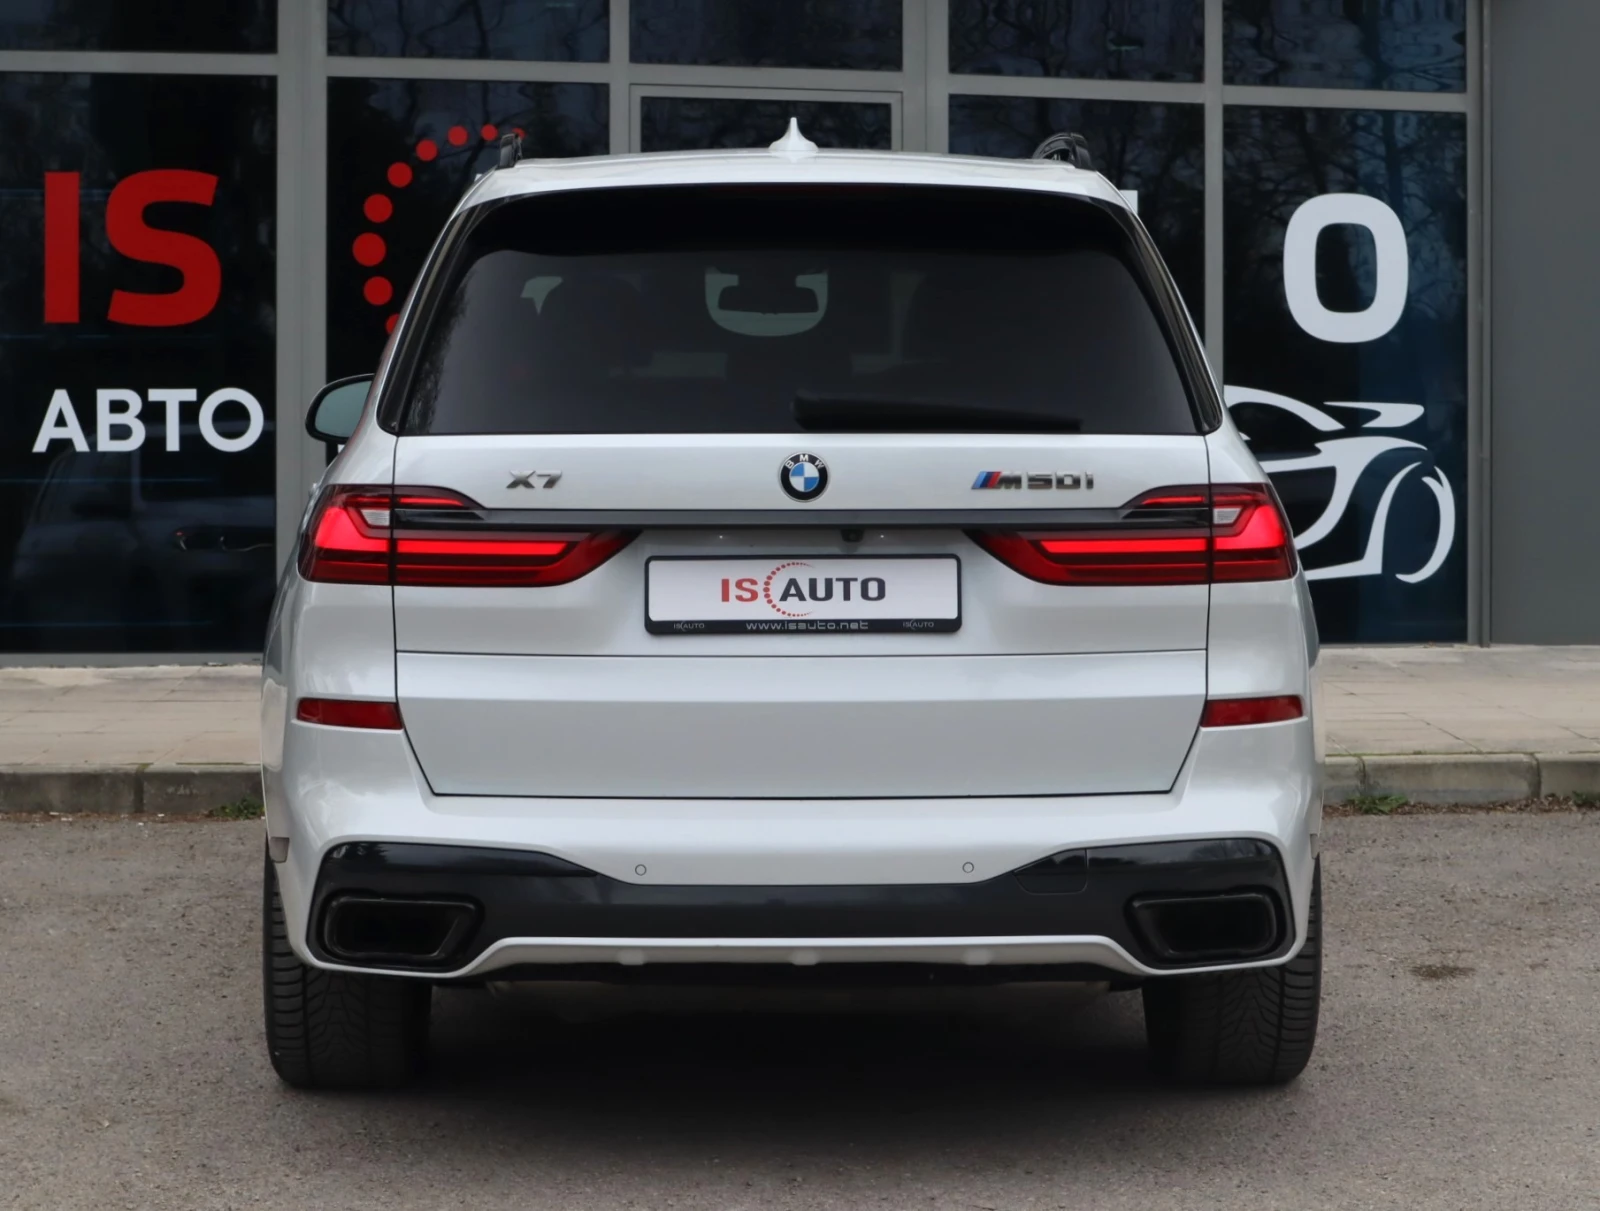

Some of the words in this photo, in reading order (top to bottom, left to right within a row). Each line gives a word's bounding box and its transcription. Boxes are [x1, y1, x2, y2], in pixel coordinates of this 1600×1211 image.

[44, 168, 222, 327] IS
[32, 387, 265, 453] АВТО
[785, 453, 825, 470] BMW
[506, 469, 563, 490] X7
[971, 470, 1095, 490] M50i
[778, 576, 887, 602] AUTO
[745, 620, 869, 631] www.isauto.net
